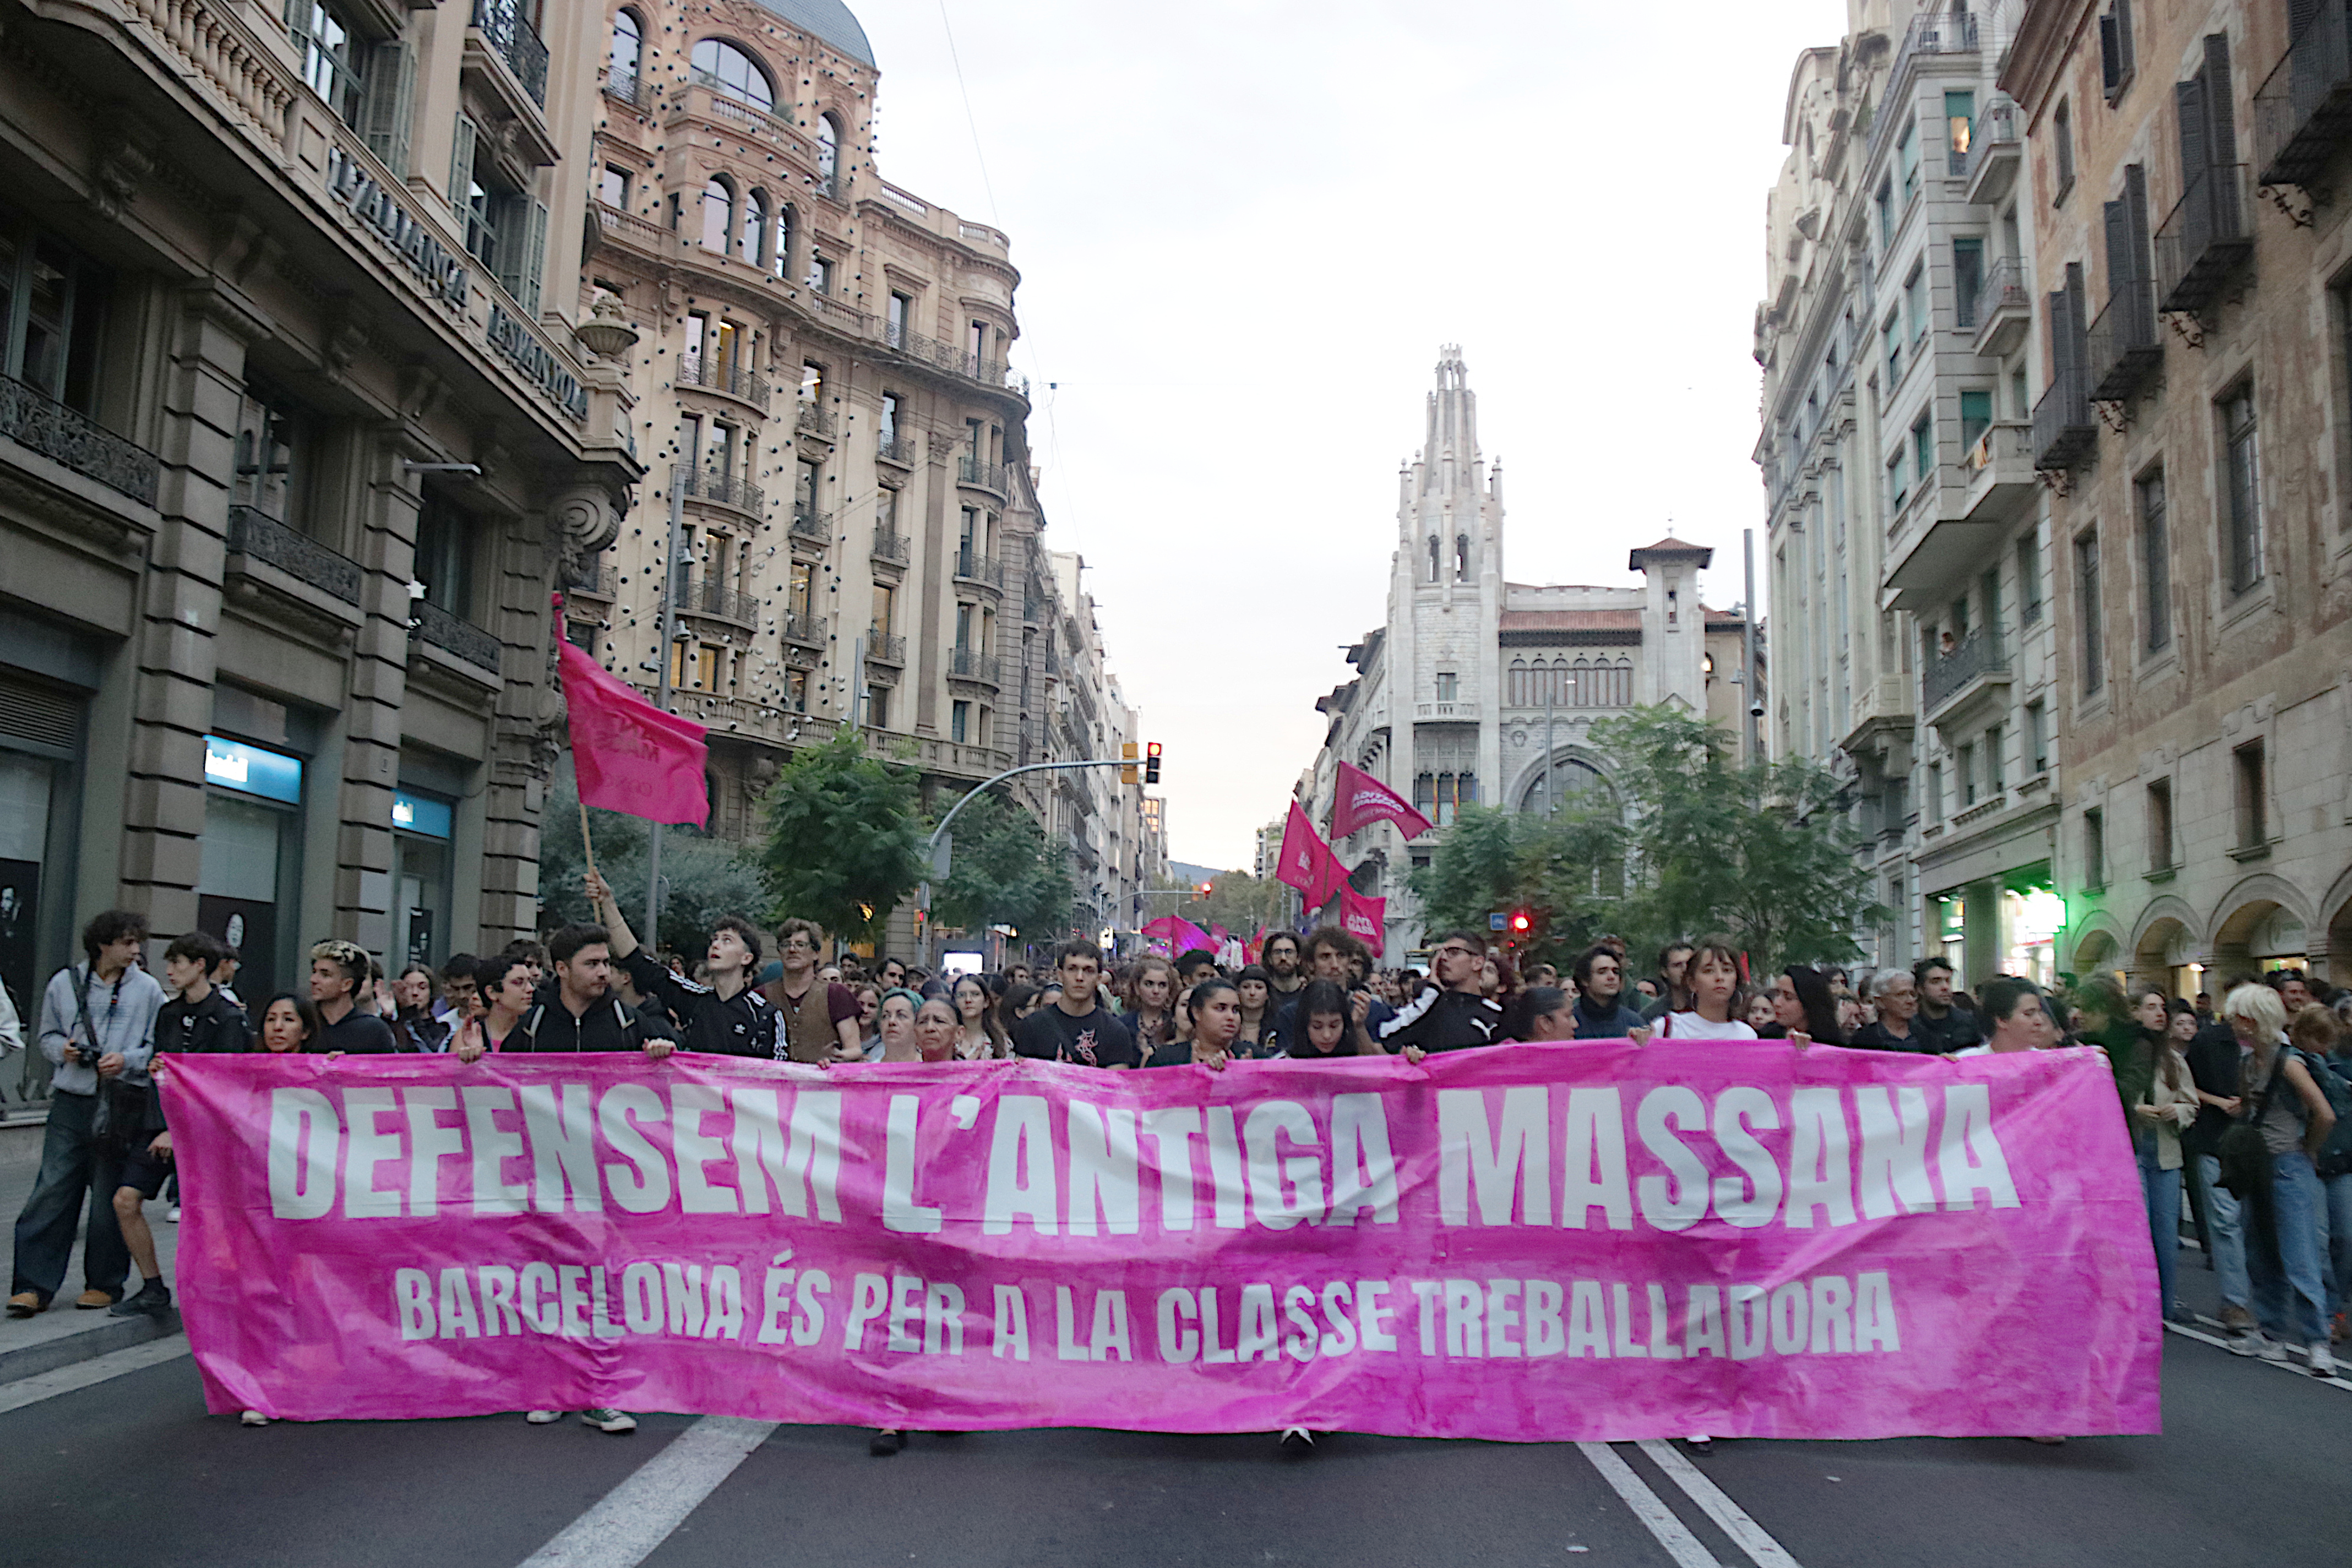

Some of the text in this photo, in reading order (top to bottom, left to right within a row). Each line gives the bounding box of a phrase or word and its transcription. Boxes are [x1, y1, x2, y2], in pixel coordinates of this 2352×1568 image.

[268, 1083, 2022, 1238] DEFENSEM L'ANTIGA MASSANA
[395, 1248, 1901, 1363] BARCELONA ÉS PER A LA CLASSE TREBALLADORA
